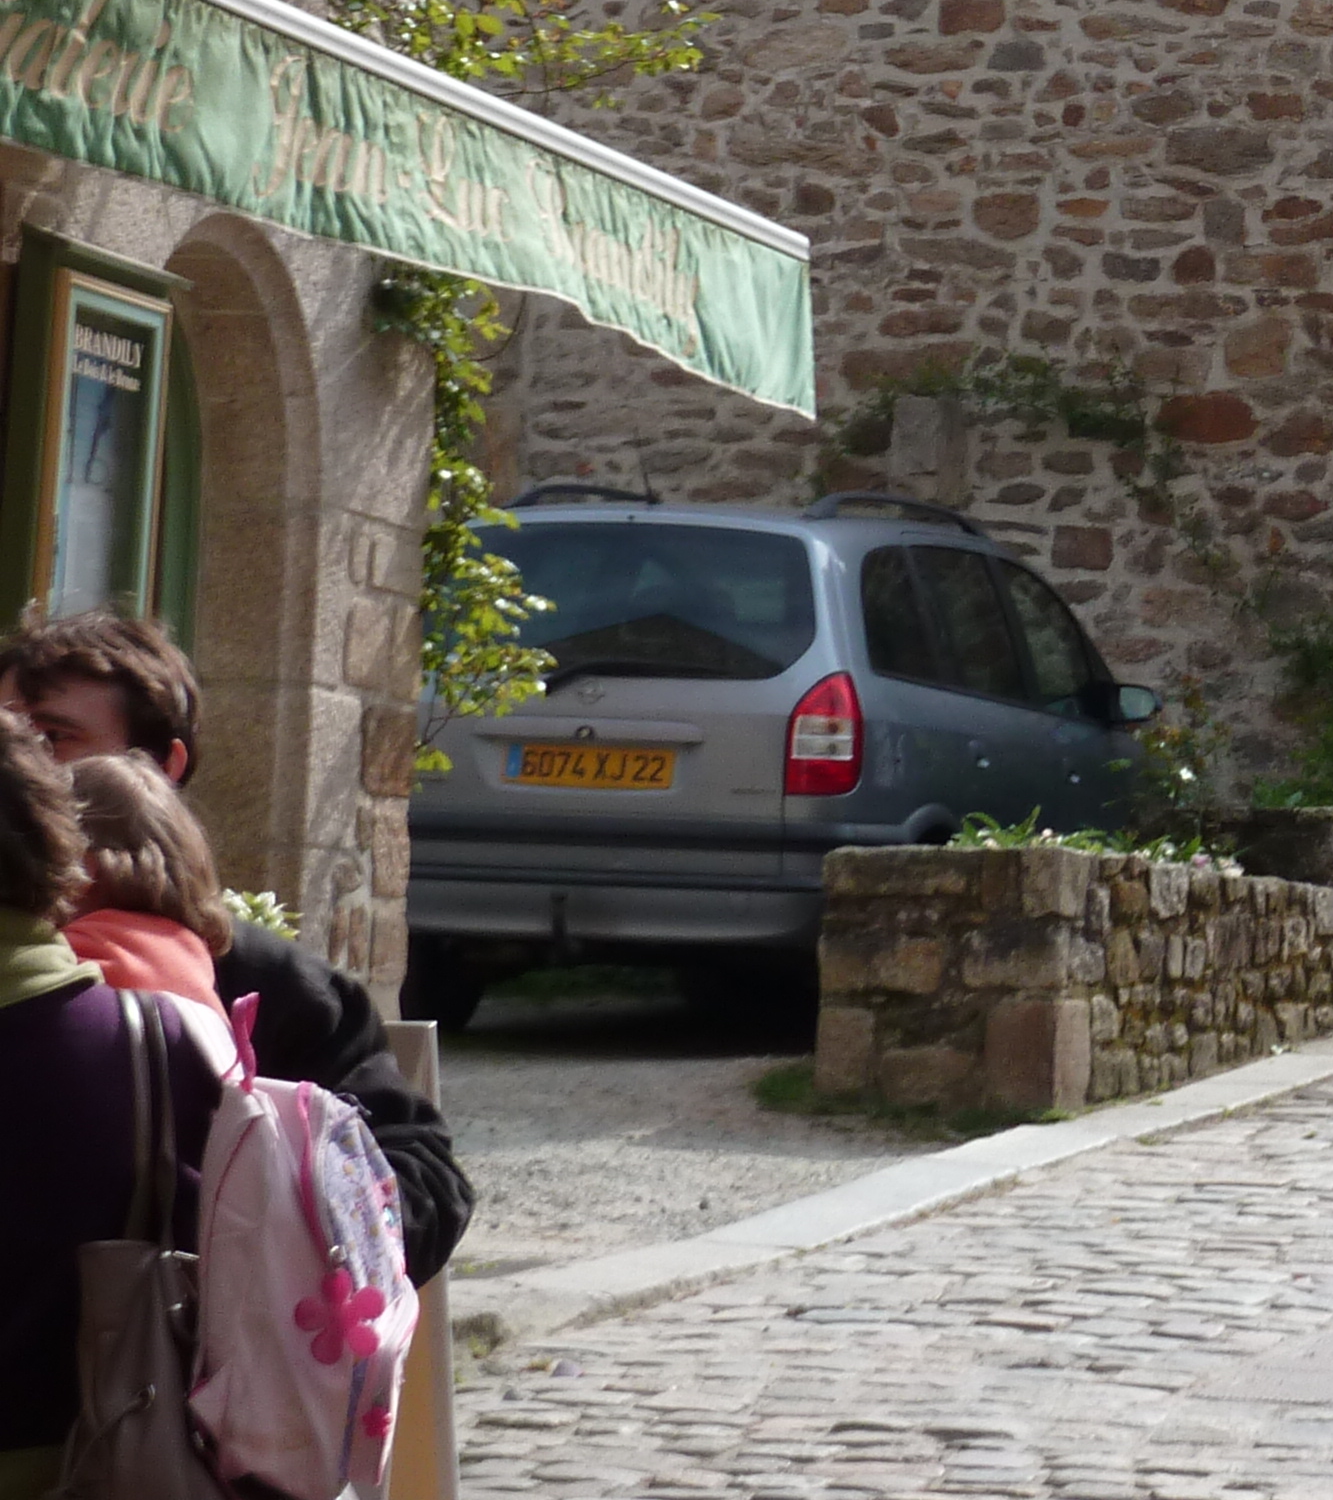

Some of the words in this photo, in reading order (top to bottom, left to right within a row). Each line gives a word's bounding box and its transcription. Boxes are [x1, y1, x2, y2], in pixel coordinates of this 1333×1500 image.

[252, 55, 515, 242] Jean-Luc
[73, 323, 144, 369] BRANDILY
[521, 751, 587, 779] 6074
[592, 752, 629, 782] XJ
[632, 754, 667, 783] 22
